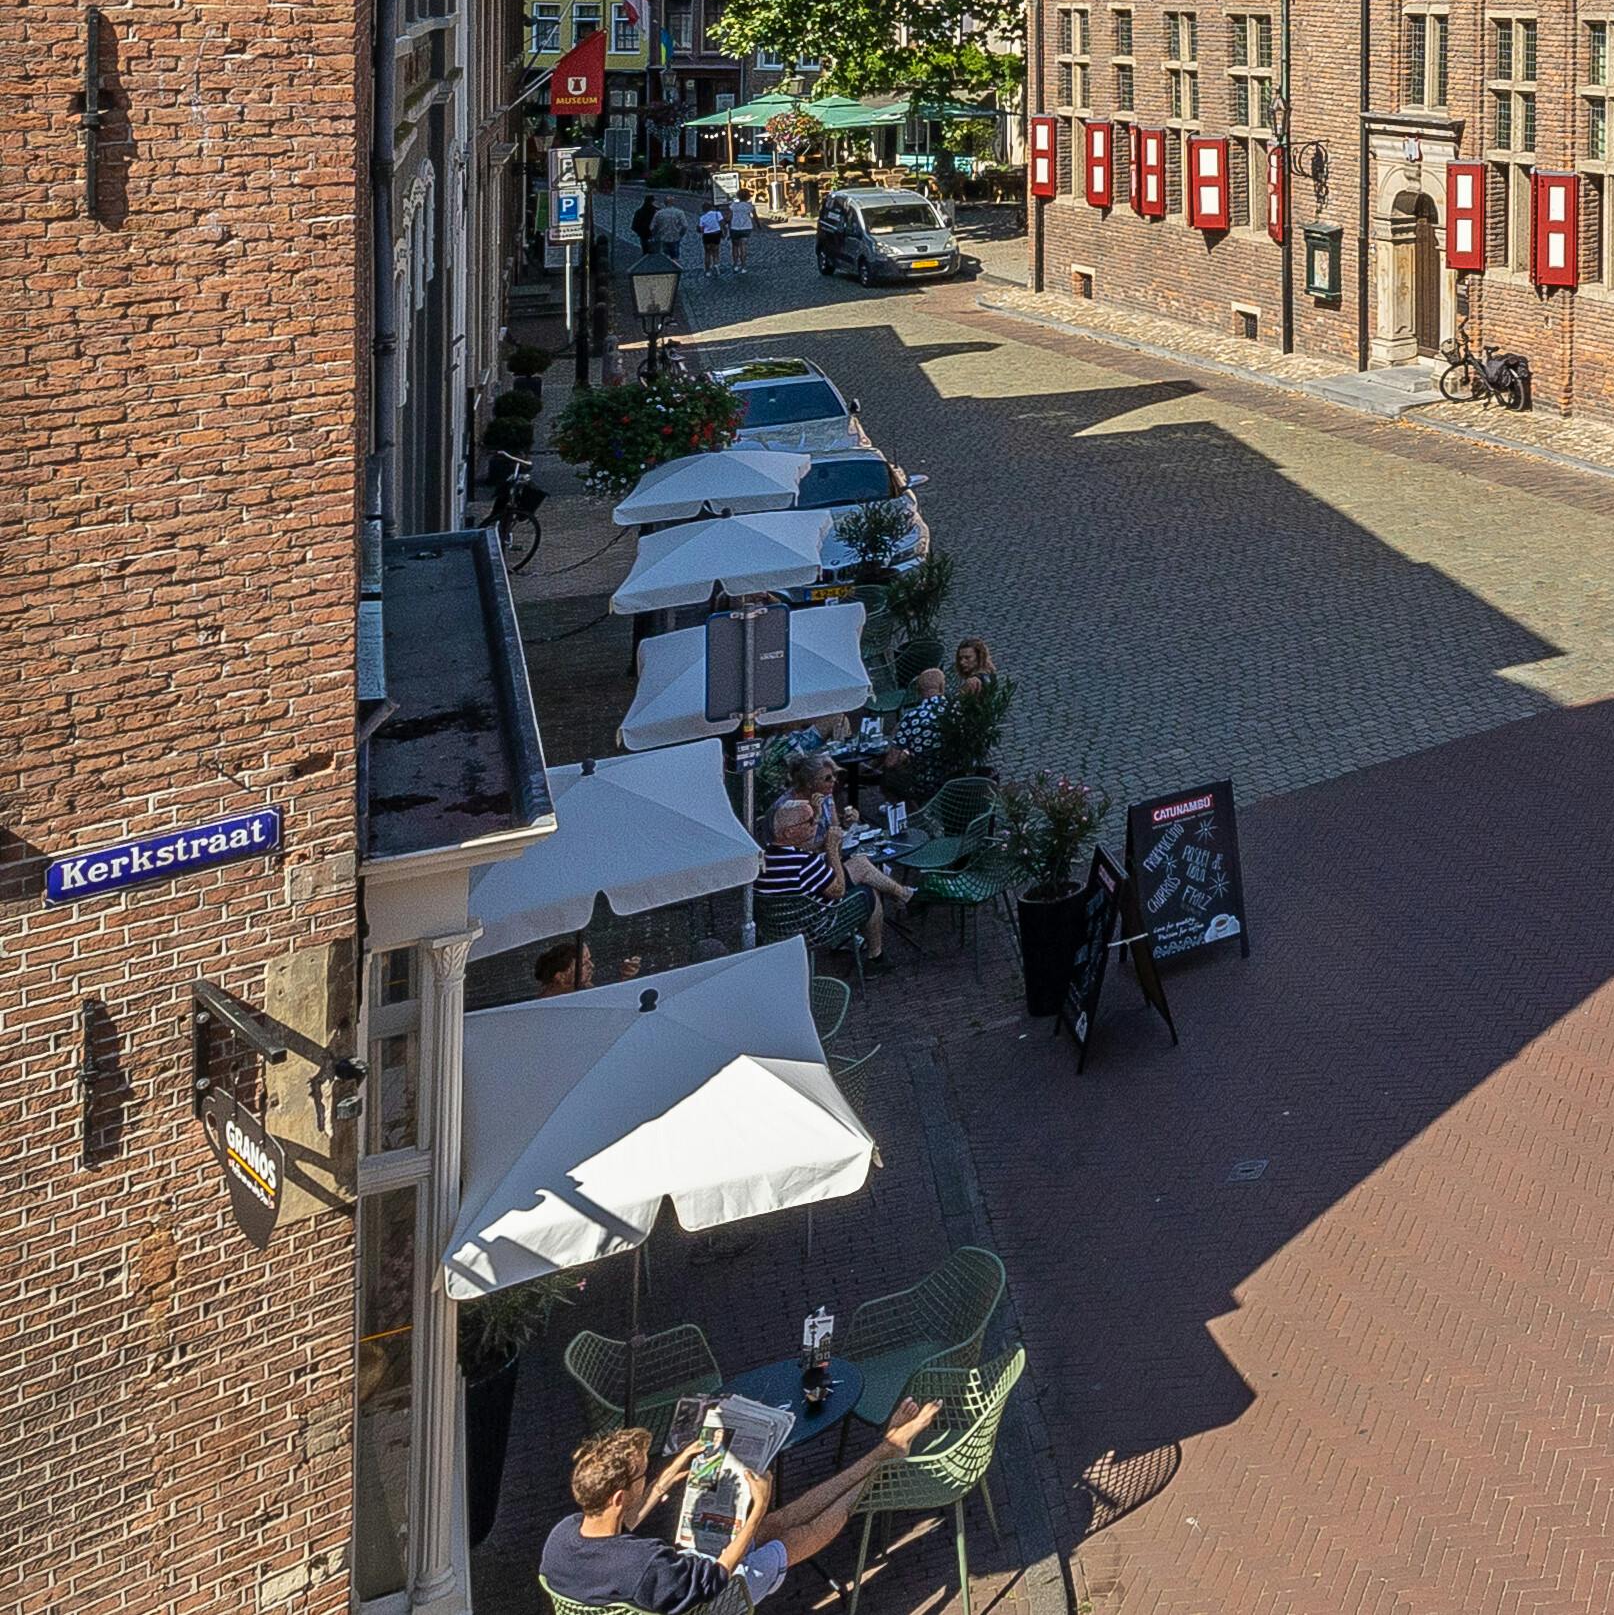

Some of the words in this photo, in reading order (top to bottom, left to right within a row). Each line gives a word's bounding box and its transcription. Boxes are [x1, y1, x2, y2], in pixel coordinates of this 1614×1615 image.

[556, 97, 598, 105] MUSEUM
[562, 198, 575, 212] P
[60, 818, 266, 891] Kerkstraat
[225, 1120, 277, 1189] GRANOS
